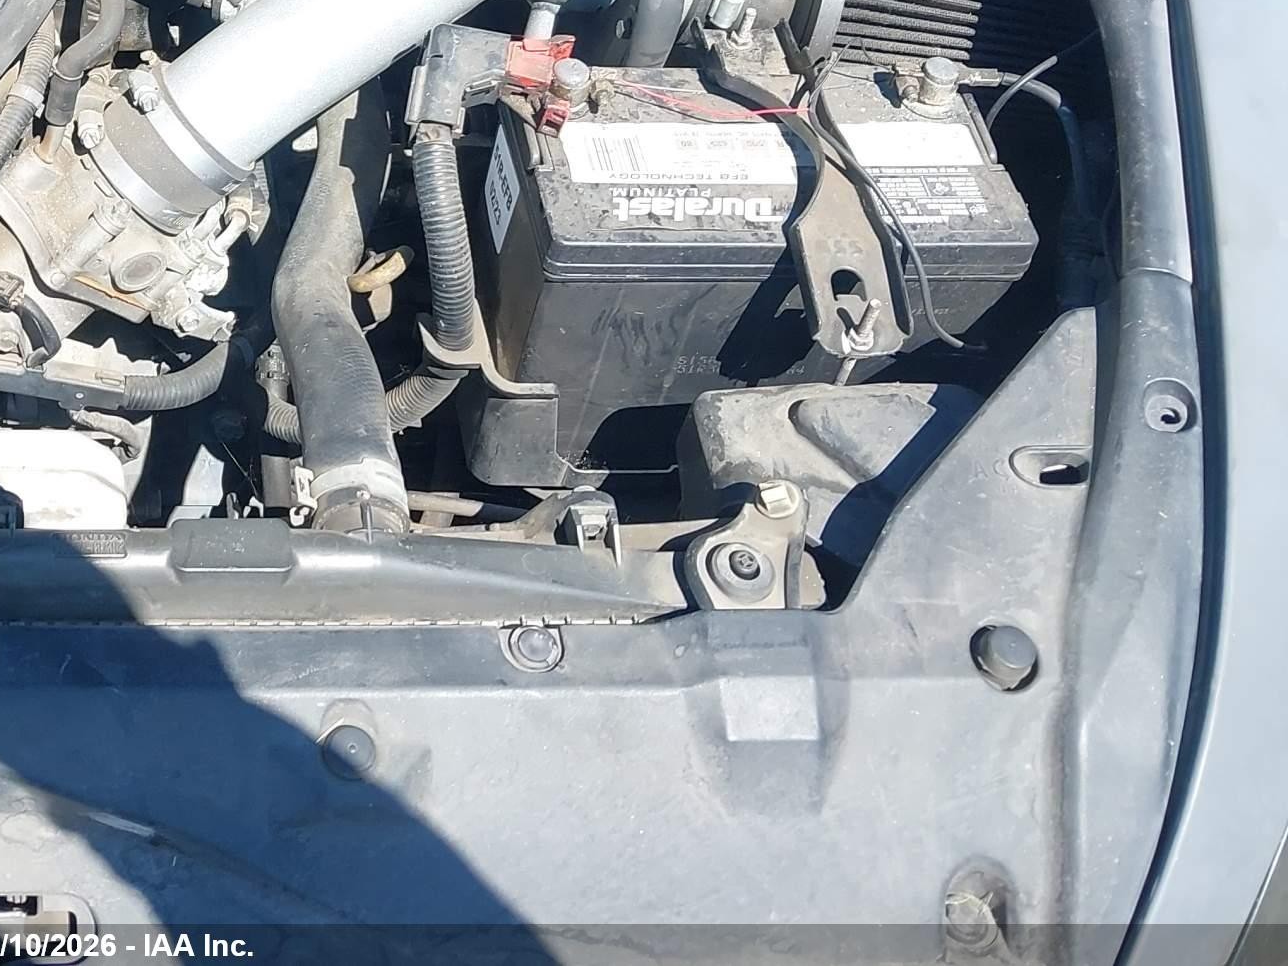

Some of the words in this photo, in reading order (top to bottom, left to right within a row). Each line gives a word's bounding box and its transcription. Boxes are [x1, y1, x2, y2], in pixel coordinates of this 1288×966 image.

[493, 143, 513, 212] 51R-EFB
[609, 173, 712, 181] TECHNOLOGY
[610, 187, 712, 198] PLATINUM
[612, 196, 784, 222] Duralast
